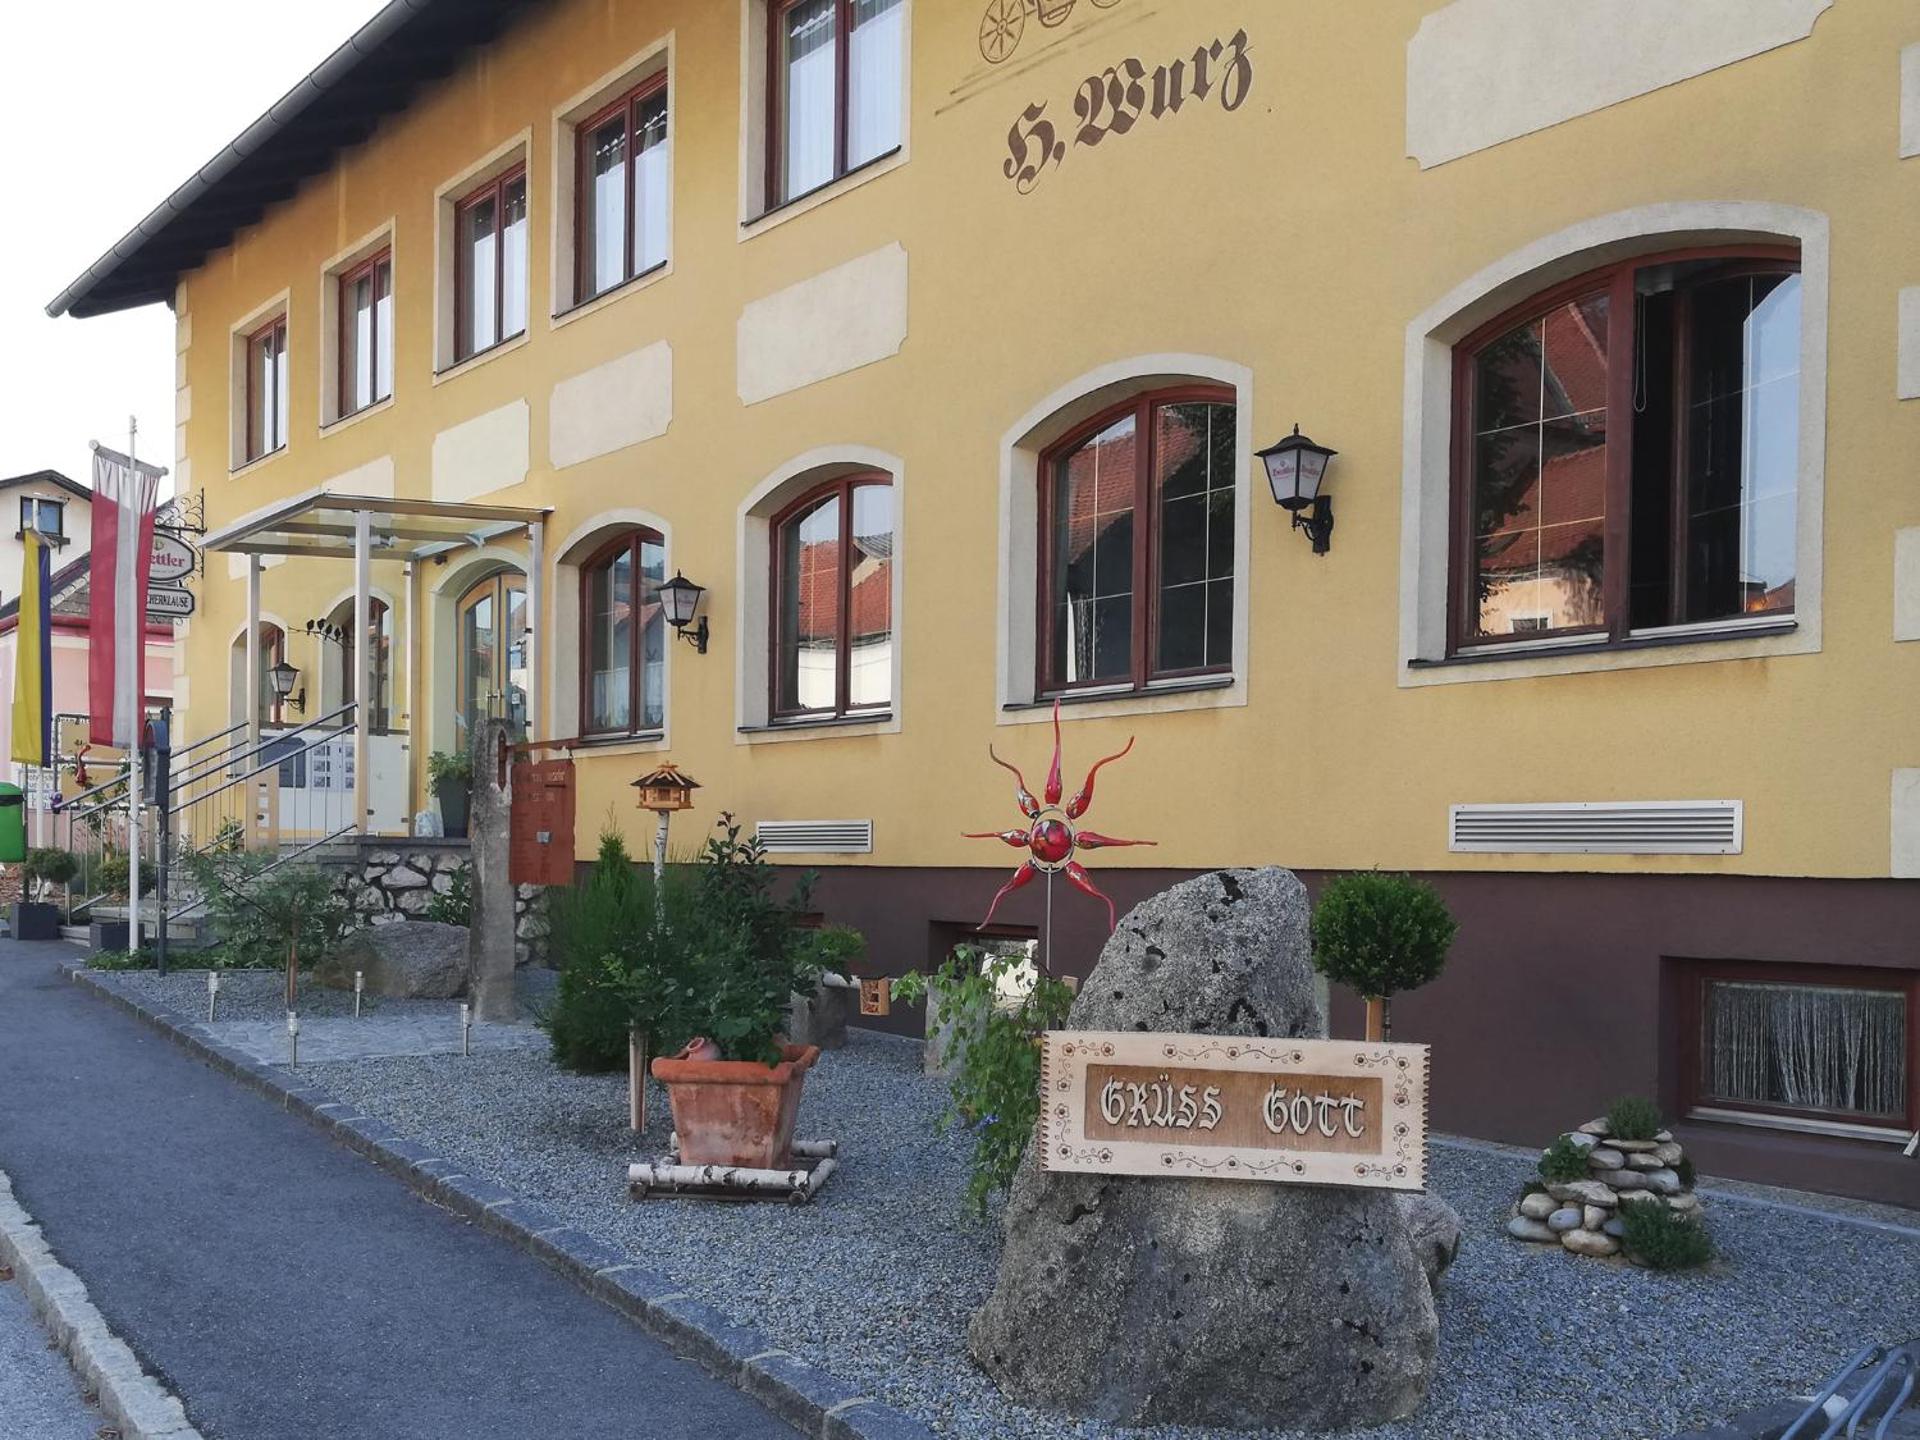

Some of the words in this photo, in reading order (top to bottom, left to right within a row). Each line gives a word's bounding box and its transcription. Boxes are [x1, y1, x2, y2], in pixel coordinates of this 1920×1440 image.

[1073, 28, 1255, 148] Wurz
[150, 552, 185, 568] ettler
[149, 593, 189, 608] HERKLAUSE
[1100, 1072, 1223, 1131] GRÜSS
[1262, 1079, 1366, 1139] GOTT
